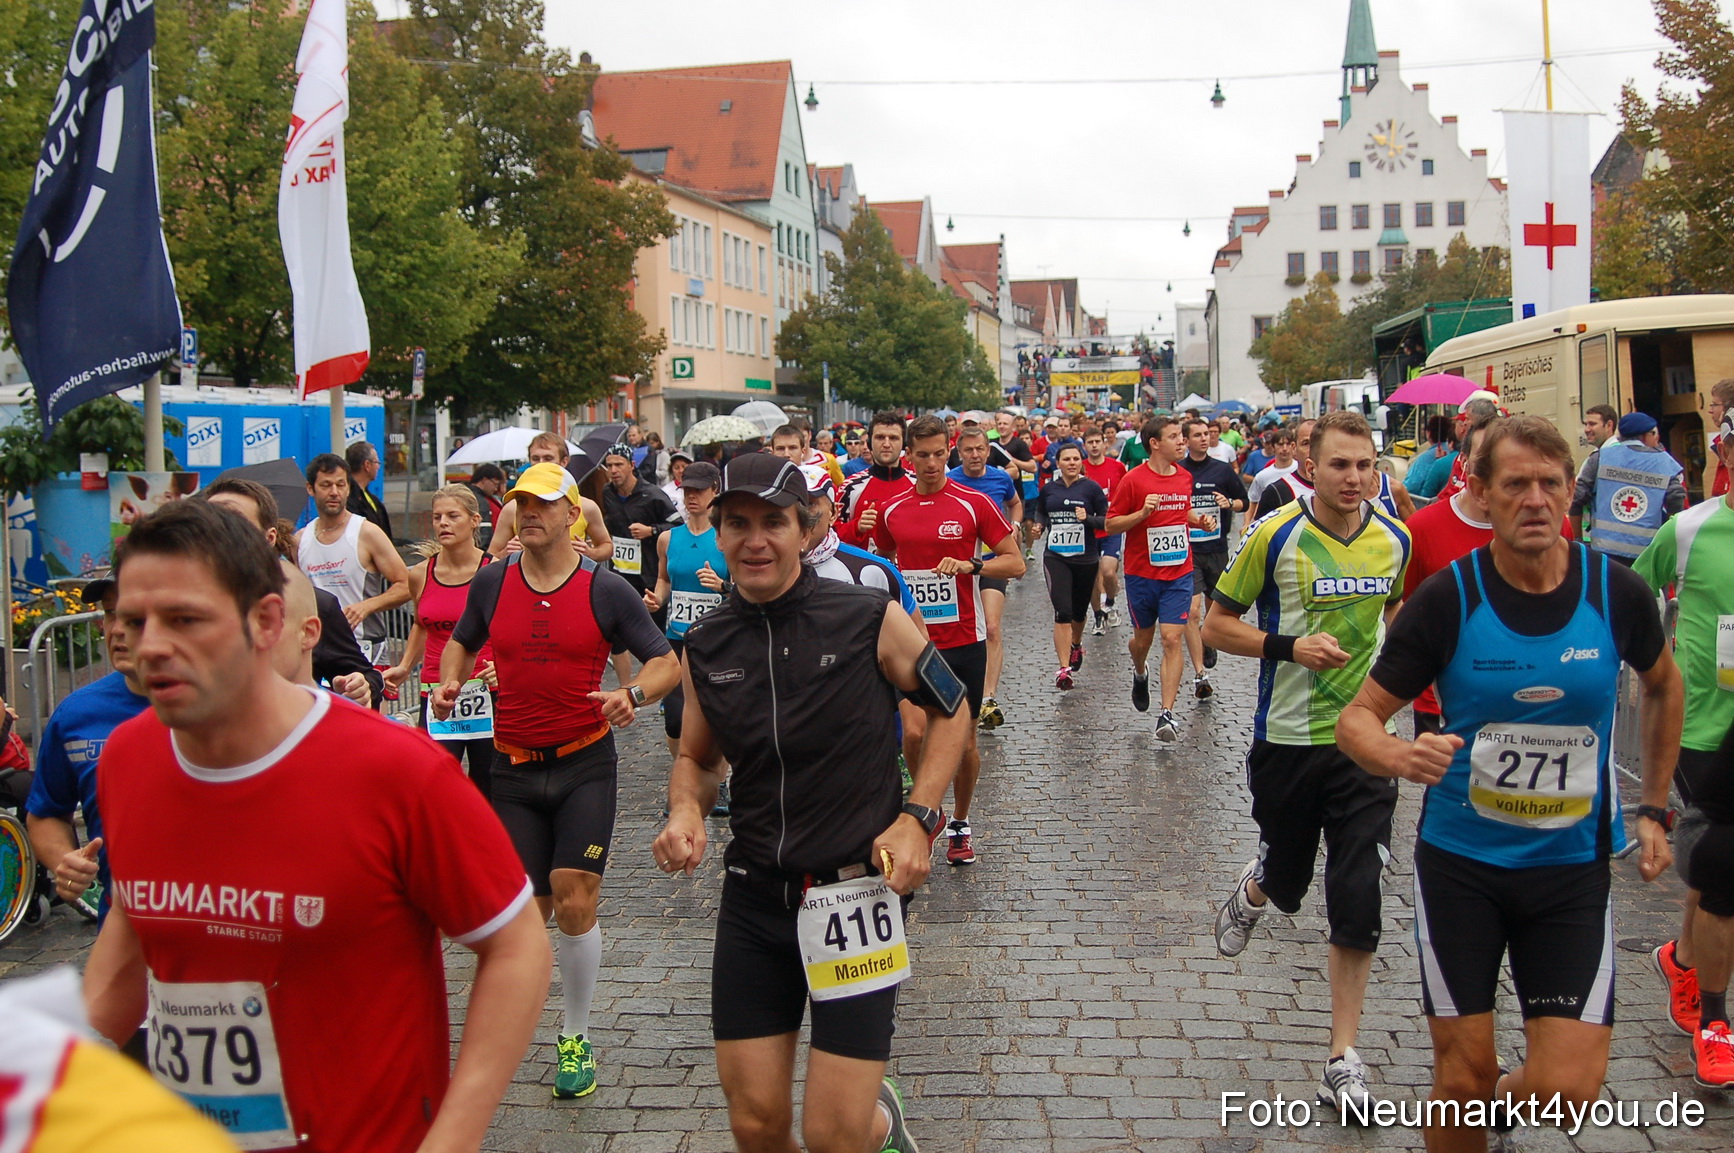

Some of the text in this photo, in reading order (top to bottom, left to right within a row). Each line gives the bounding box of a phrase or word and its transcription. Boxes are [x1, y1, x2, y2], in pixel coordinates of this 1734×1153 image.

[674, 359, 692, 377] D
[1503, 354, 1553, 382] Bayerisches
[1080, 374, 1110, 383] START
[1503, 385, 1527, 403] Rotes
[188, 422, 221, 447] DIXI
[244, 423, 279, 447] DIXI
[345, 422, 366, 439] IXI
[1606, 468, 1664, 486] TECHNISCHER DIENST
[1159, 493, 1188, 502] Klinikum
[1052, 531, 1081, 544] 3177
[1153, 534, 1185, 551] 2343
[615, 546, 635, 560] 570
[1313, 577, 1391, 596] BOCK
[921, 608, 944, 617] omas
[422, 617, 459, 632] Fre
[1574, 648, 1599, 660] asics
[450, 724, 472, 732] Silke
[1478, 732, 1578, 747] PARTL Neumarkt
[1495, 749, 1570, 791] 271
[119, 879, 284, 923] NEUMARKT
[801, 884, 888, 912] ARTL Neumarkt
[206, 925, 283, 943] STARKE STADT
[824, 900, 893, 952] 416
[834, 952, 894, 981] Manfred
[161, 999, 237, 1017] Neumarkt
[151, 1014, 263, 1086] 2379
